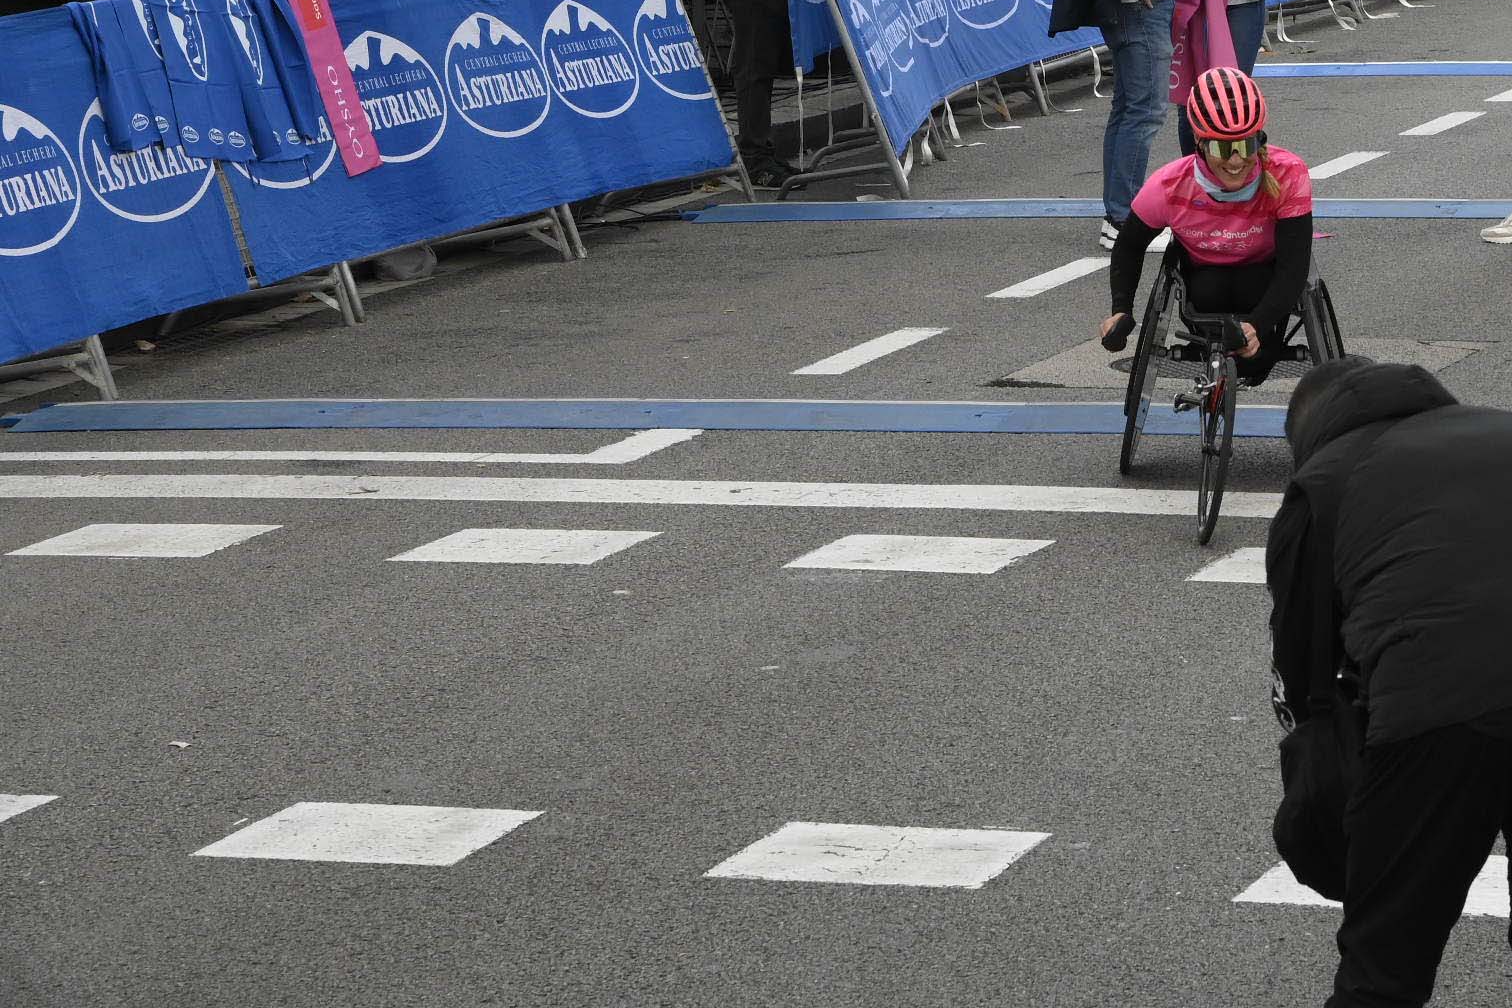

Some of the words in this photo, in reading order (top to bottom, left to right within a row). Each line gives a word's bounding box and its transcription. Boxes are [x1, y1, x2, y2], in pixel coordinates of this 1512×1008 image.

[558, 42, 588, 56] CENTRAL
[588, 37, 617, 51] LECHERA
[652, 25, 685, 39] CENTRAL
[464, 55, 498, 71] CENTRAL
[499, 50, 531, 66] LECHERA
[642, 32, 704, 76] ASTUR
[389, 69, 427, 86] LECHERA
[456, 62, 547, 111] ASTURIANA
[551, 48, 635, 93] ASTURIANA
[360, 86, 442, 133] STURIANA
[15, 145, 57, 164] LECHERA
[0, 166, 76, 218] URIANA
